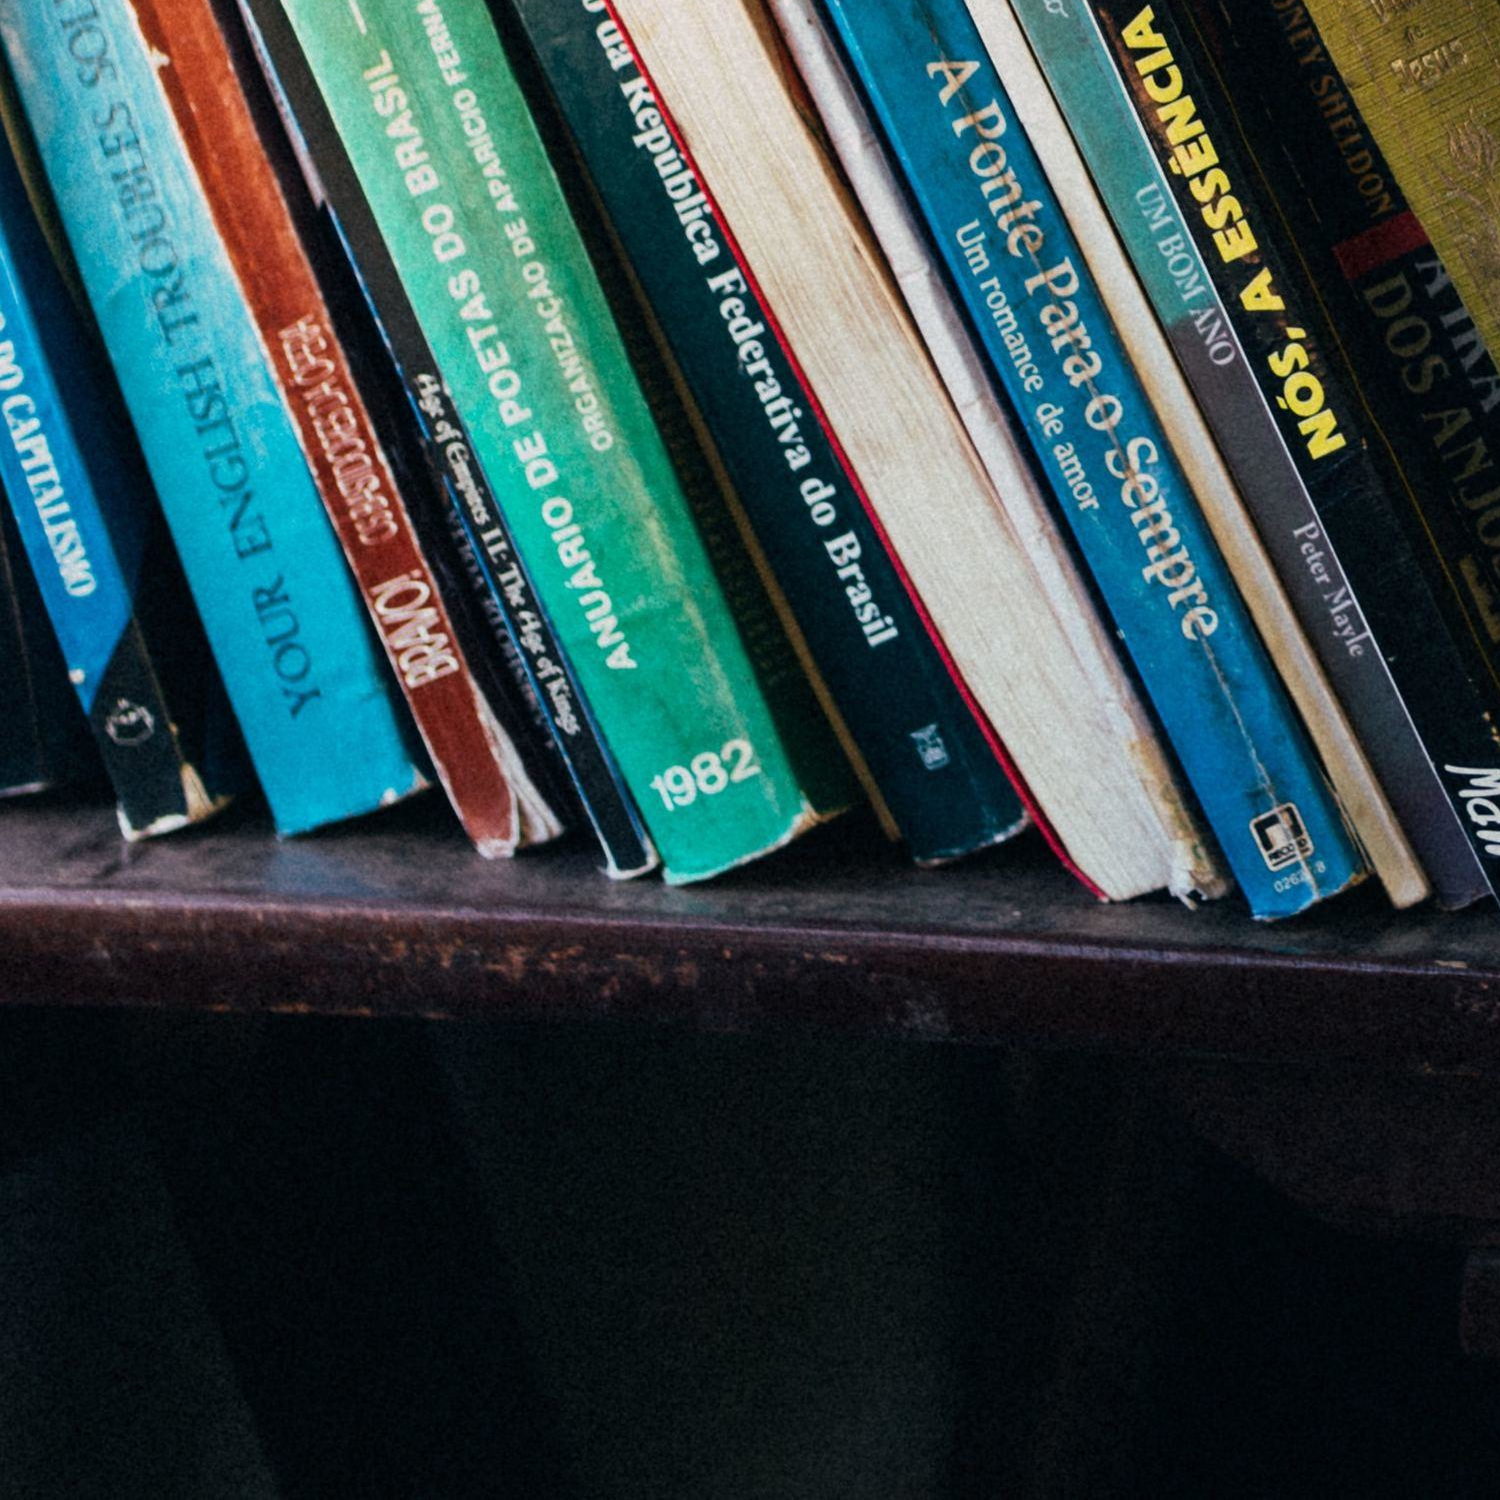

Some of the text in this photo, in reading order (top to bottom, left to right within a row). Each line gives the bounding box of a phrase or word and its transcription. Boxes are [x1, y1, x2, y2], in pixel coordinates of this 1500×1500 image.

[363, 49, 438, 198] BRASIL
[453, 87, 511, 197] APARÍCIO
[1311, 72, 1396, 220] SHELDON
[92, 100, 198, 347] TROUBLES
[422, 209, 466, 263] DO
[504, 216, 536, 253] DE
[1121, 5, 1347, 460] NÓS, A ESSÊNCIA
[1135, 183, 1236, 367] UM BOM ANO
[449, 267, 534, 426] POETAS
[522, 260, 614, 451] ORGANIZAÇÃO
[620, 72, 724, 268] República
[705, 268, 816, 472] Federativa
[799, 475, 837, 528] do
[824, 530, 899, 650] Brasil
[927, 60, 1219, 641] A Ponte Para O Sempre
[955, 220, 1101, 514] Um romance de amor
[1356, 269, 1456, 398] DOS
[7, 393, 97, 598] CAPITALISMO
[177, 355, 273, 559] ENGLISH
[515, 431, 559, 490] DE
[253, 573, 323, 719] YOUR
[368, 569, 459, 688] BRAVO!
[543, 497, 638, 670] ANUÁRIO
[1293, 520, 1364, 658] Peter Mayle
[650, 738, 761, 811] 1982
